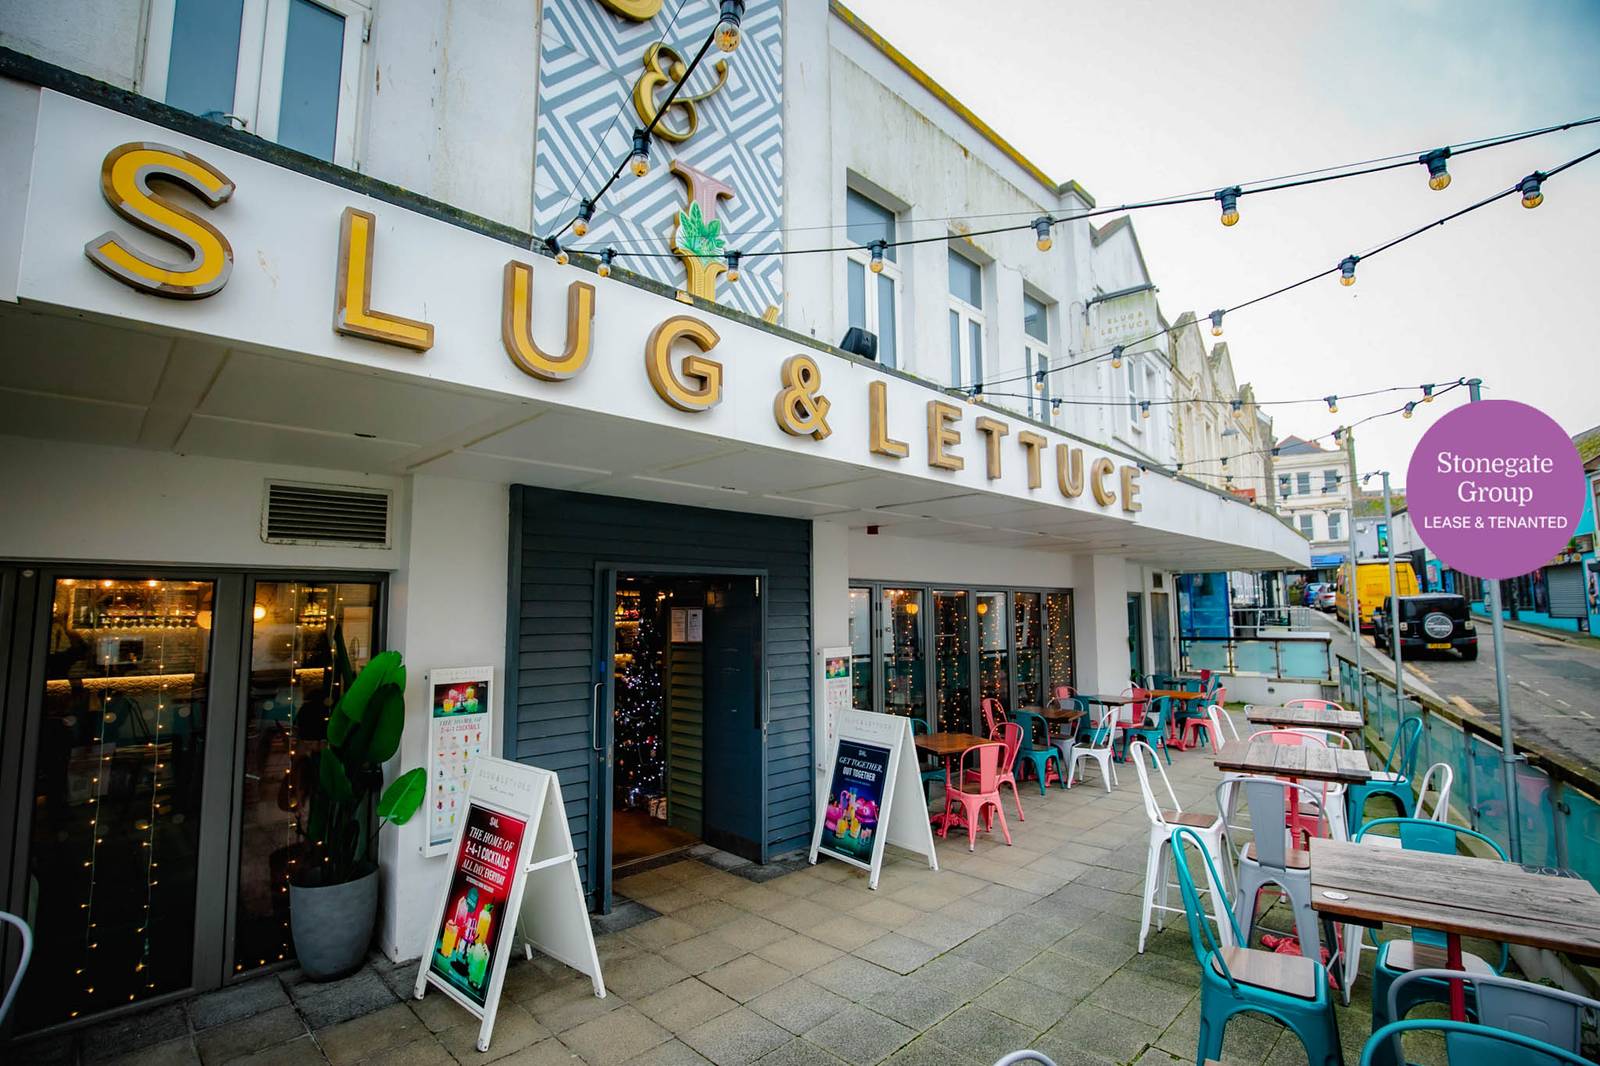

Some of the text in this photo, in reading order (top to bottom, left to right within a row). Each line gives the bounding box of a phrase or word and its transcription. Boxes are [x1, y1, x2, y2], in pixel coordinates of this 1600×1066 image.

[85, 141, 1143, 512] SLUG & LETTUCE
[839, 756, 852, 765] GET
[843, 766, 852, 776] OUT
[853, 768, 876, 782] TOGETHER
[469, 826, 515, 853] THE HOME OF
[465, 841, 510, 870] 2-4-1 COCKTAILS
[462, 859, 473, 871] ALL
[484, 867, 506, 886] EVERYDAY
